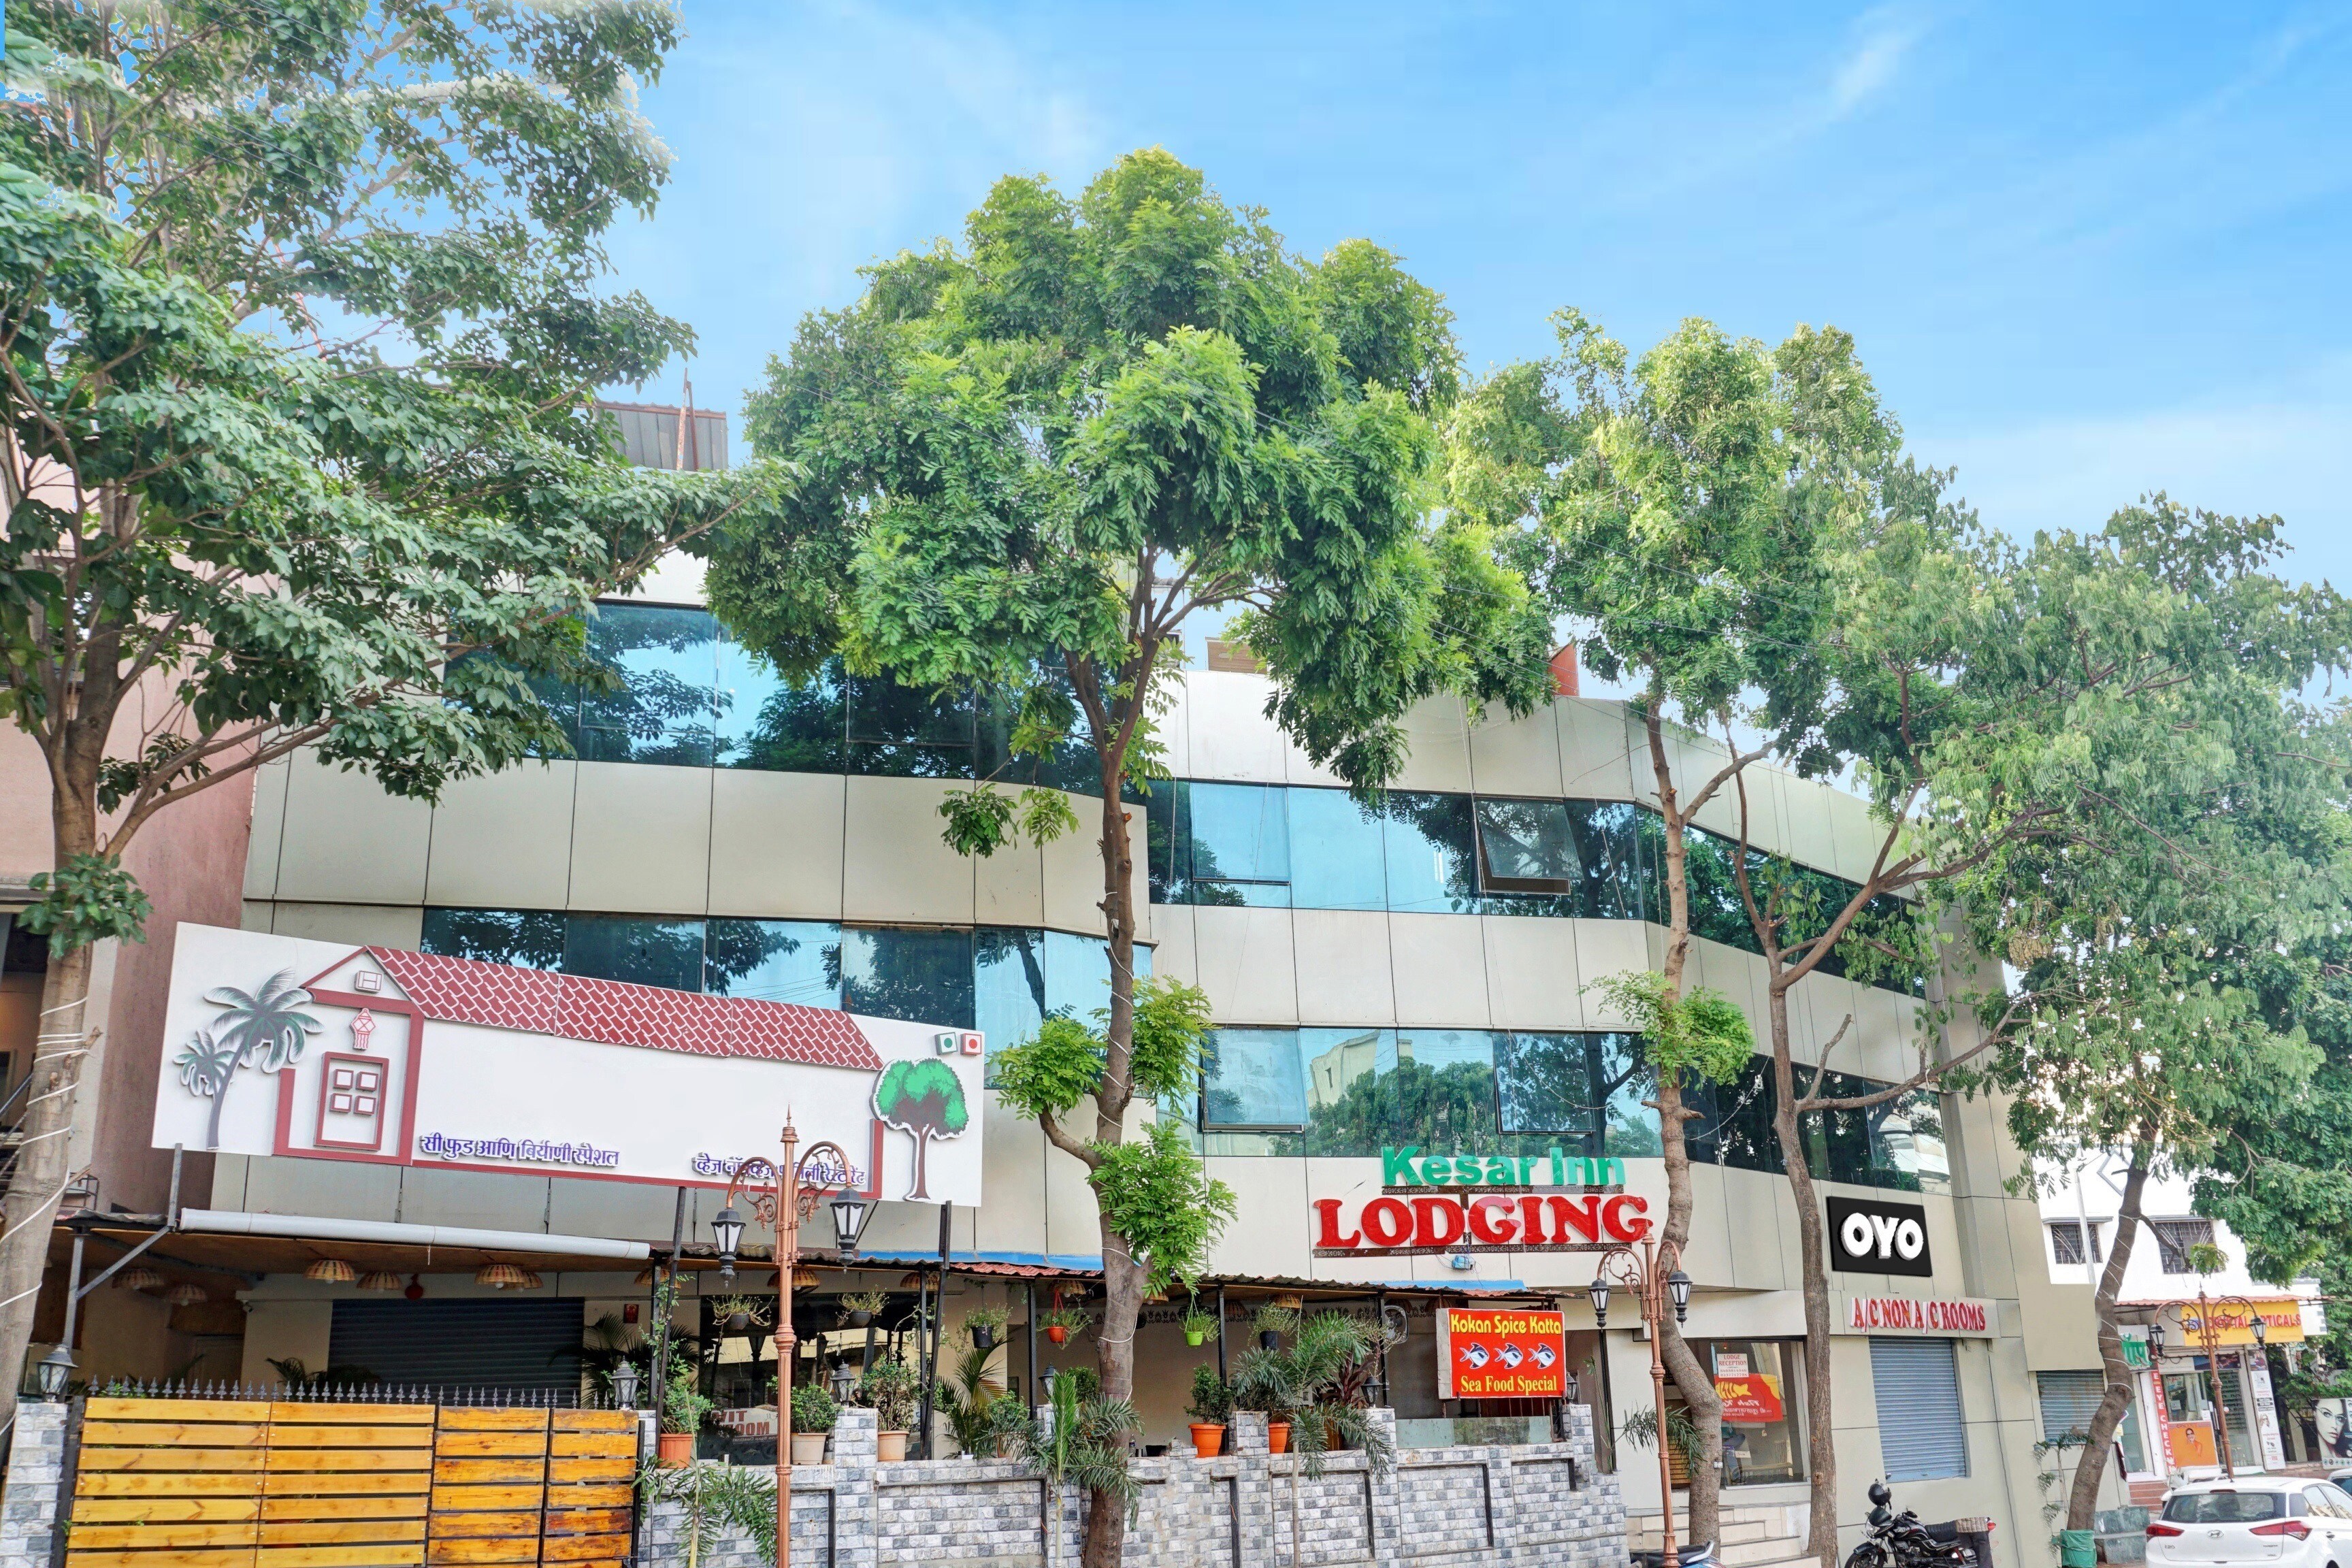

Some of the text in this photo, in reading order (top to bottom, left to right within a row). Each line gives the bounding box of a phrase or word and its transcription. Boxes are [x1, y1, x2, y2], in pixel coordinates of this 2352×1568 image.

[421, 1132, 442, 1153] सी
[446, 1137, 474, 1159] फुड
[477, 1137, 516, 1158] आणि
[575, 1142, 620, 1166] स्पेशल
[696, 1152, 723, 1175] व्हेज
[1381, 1146, 1627, 1186] Kesar Inn
[1313, 1194, 1654, 1248] LODGING
[1841, 1212, 1924, 1261] OYO
[1450, 1313, 1563, 1339] Kokan Spice Katta
[1850, 1296, 1987, 1334] A/C NON A/C ROOMS
[1460, 1375, 1558, 1396] Sea Food Special
[2155, 1386, 2164, 1410] EYE
